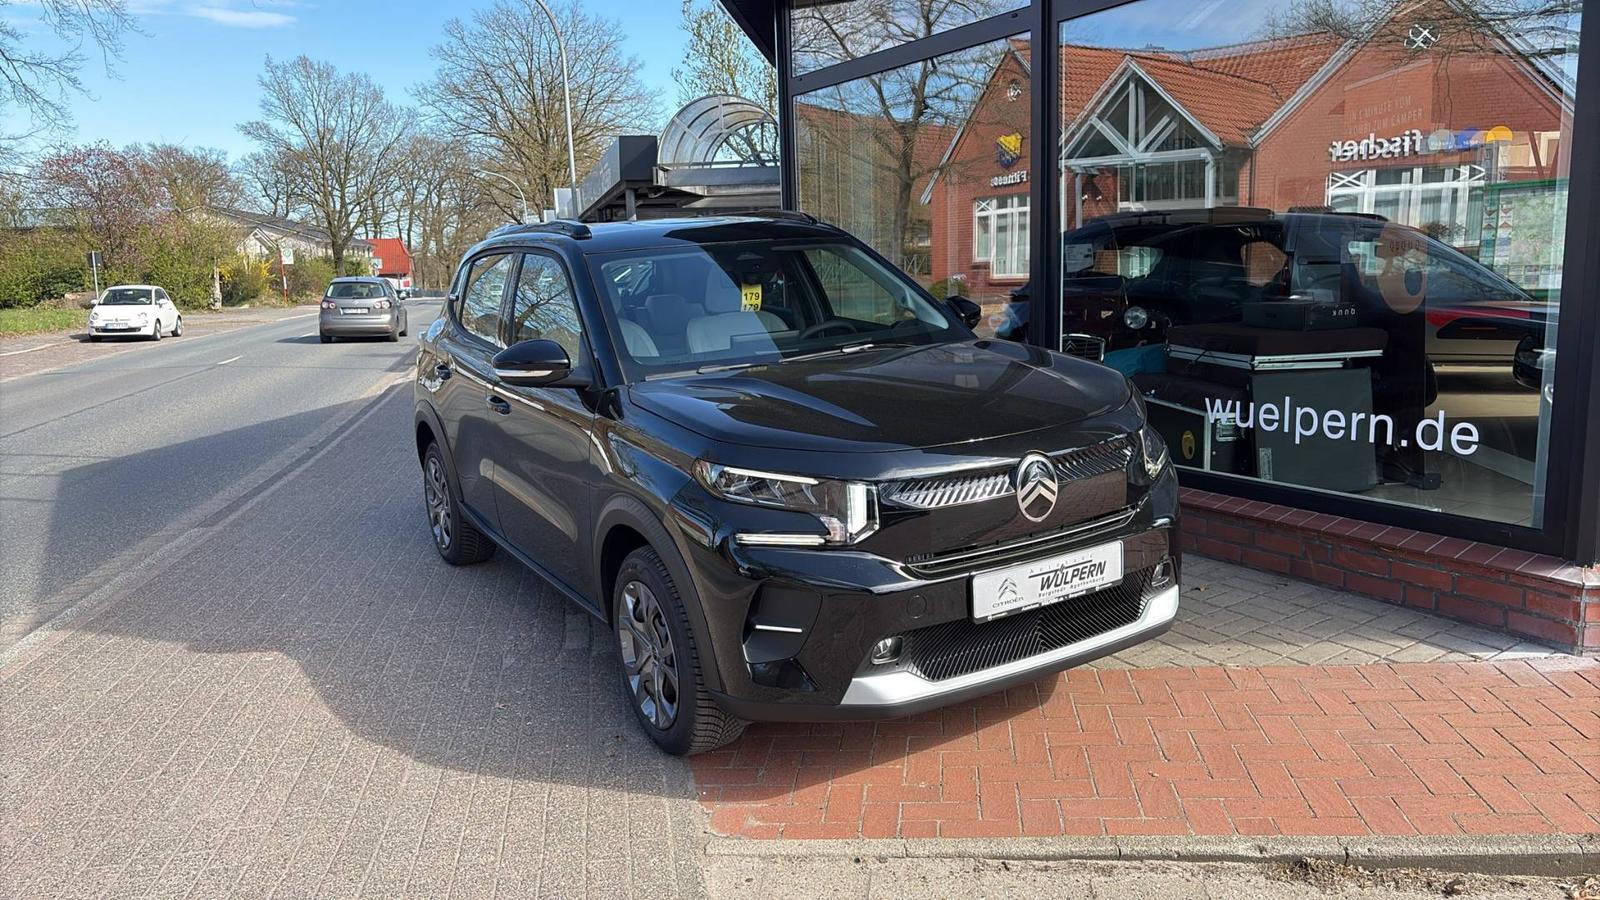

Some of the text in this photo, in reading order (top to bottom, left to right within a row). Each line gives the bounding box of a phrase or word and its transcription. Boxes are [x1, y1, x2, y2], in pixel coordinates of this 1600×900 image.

[1391, 108, 1423, 127] CAMPER
[743, 292, 760, 301] 179
[1205, 396, 1480, 455] wuelpern.de
[992, 595, 1024, 609] CITROËN
